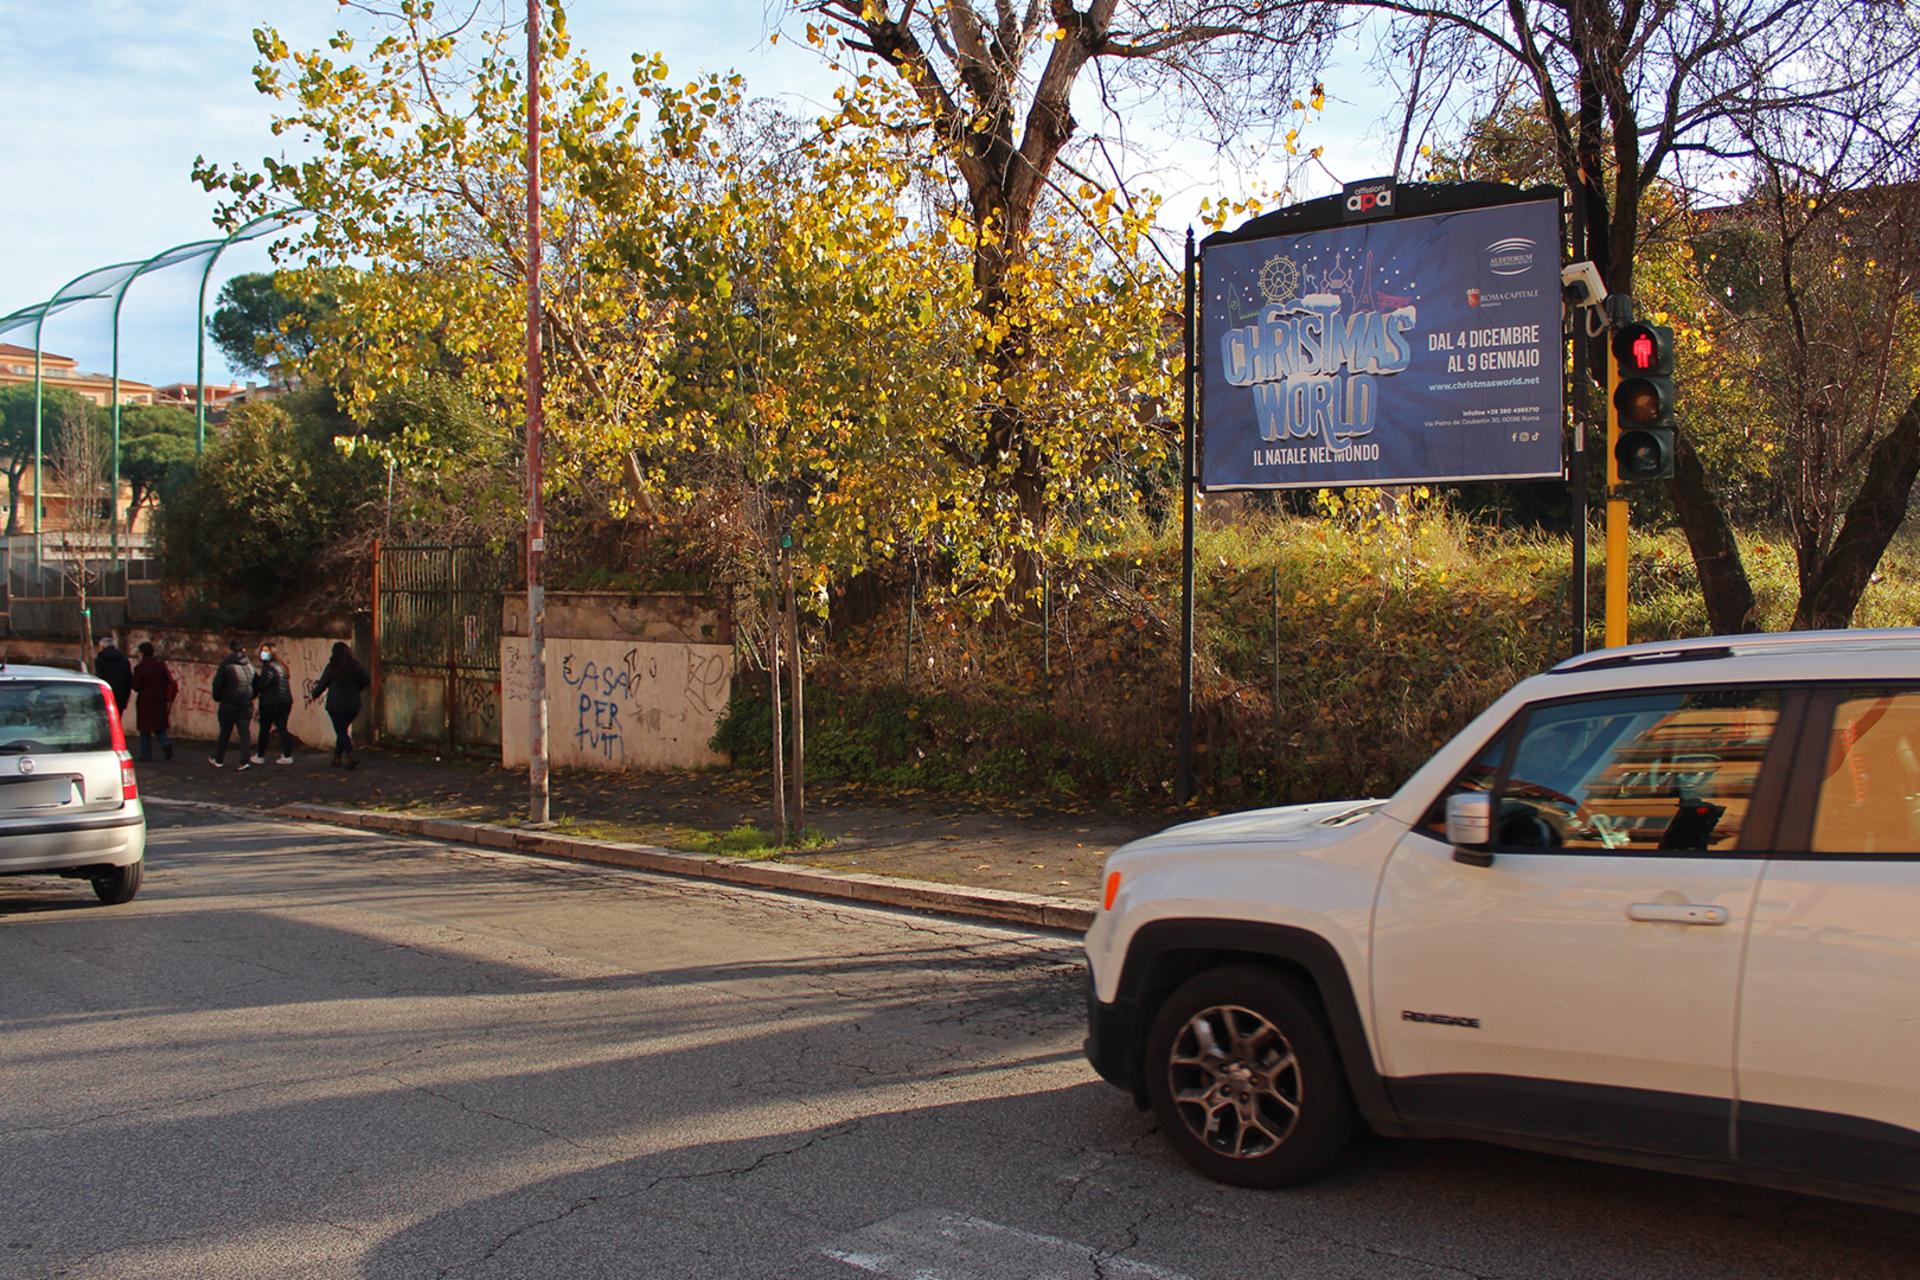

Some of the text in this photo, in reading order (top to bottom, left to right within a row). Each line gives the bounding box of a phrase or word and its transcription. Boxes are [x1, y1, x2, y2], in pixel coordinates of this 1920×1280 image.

[1346, 190, 1392, 215] apa
[1481, 289, 1539, 302] ROMA CAPITALE
[1221, 299, 1416, 385] CHRISTMAS
[1428, 325, 1540, 352] DAL 4 DICEMBRE
[1447, 348, 1540, 373] AL 9 GENNAIO
[1429, 376, 1540, 391] www.christmasworld.net
[1252, 374, 1378, 453] WORLD
[1254, 443, 1380, 466] IL NATALE NEL MONDO
[579, 694, 623, 731] PER
